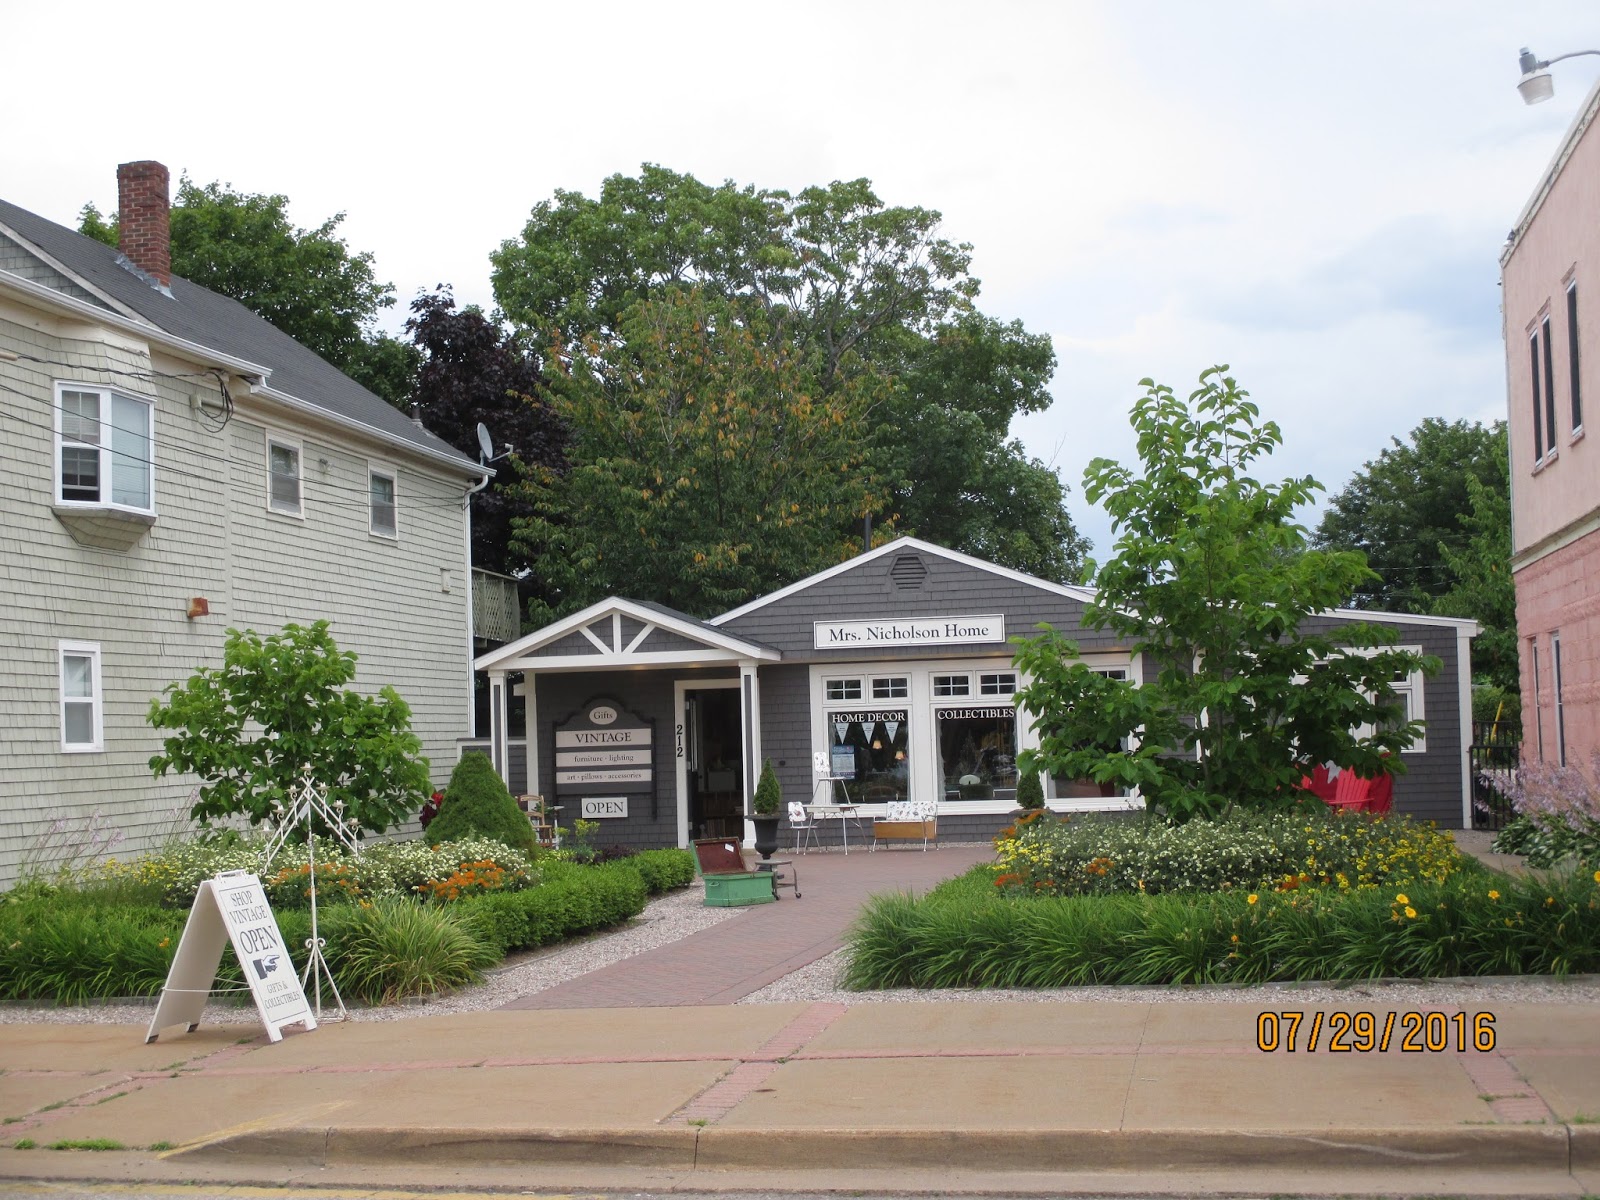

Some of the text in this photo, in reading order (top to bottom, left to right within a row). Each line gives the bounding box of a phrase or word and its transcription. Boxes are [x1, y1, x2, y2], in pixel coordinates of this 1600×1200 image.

[829, 623, 989, 642] Mrs. Nicholson Home
[593, 711, 613, 720] Gifts
[832, 712, 905, 723] HOME DECOR
[937, 708, 1015, 720] COLLECTIBLES
[575, 731, 632, 743] VINTAGE
[574, 754, 634, 763] furniture lighting
[566, 773, 577, 781] art
[580, 772, 603, 781] pillows
[585, 802, 624, 814] OPEN
[230, 890, 253, 907] SHOP
[229, 906, 267, 923] VINTAGE
[239, 925, 278, 954] OPEN
[267, 982, 282, 993] GIFTS
[264, 991, 300, 1009] COLLECTIBLES
